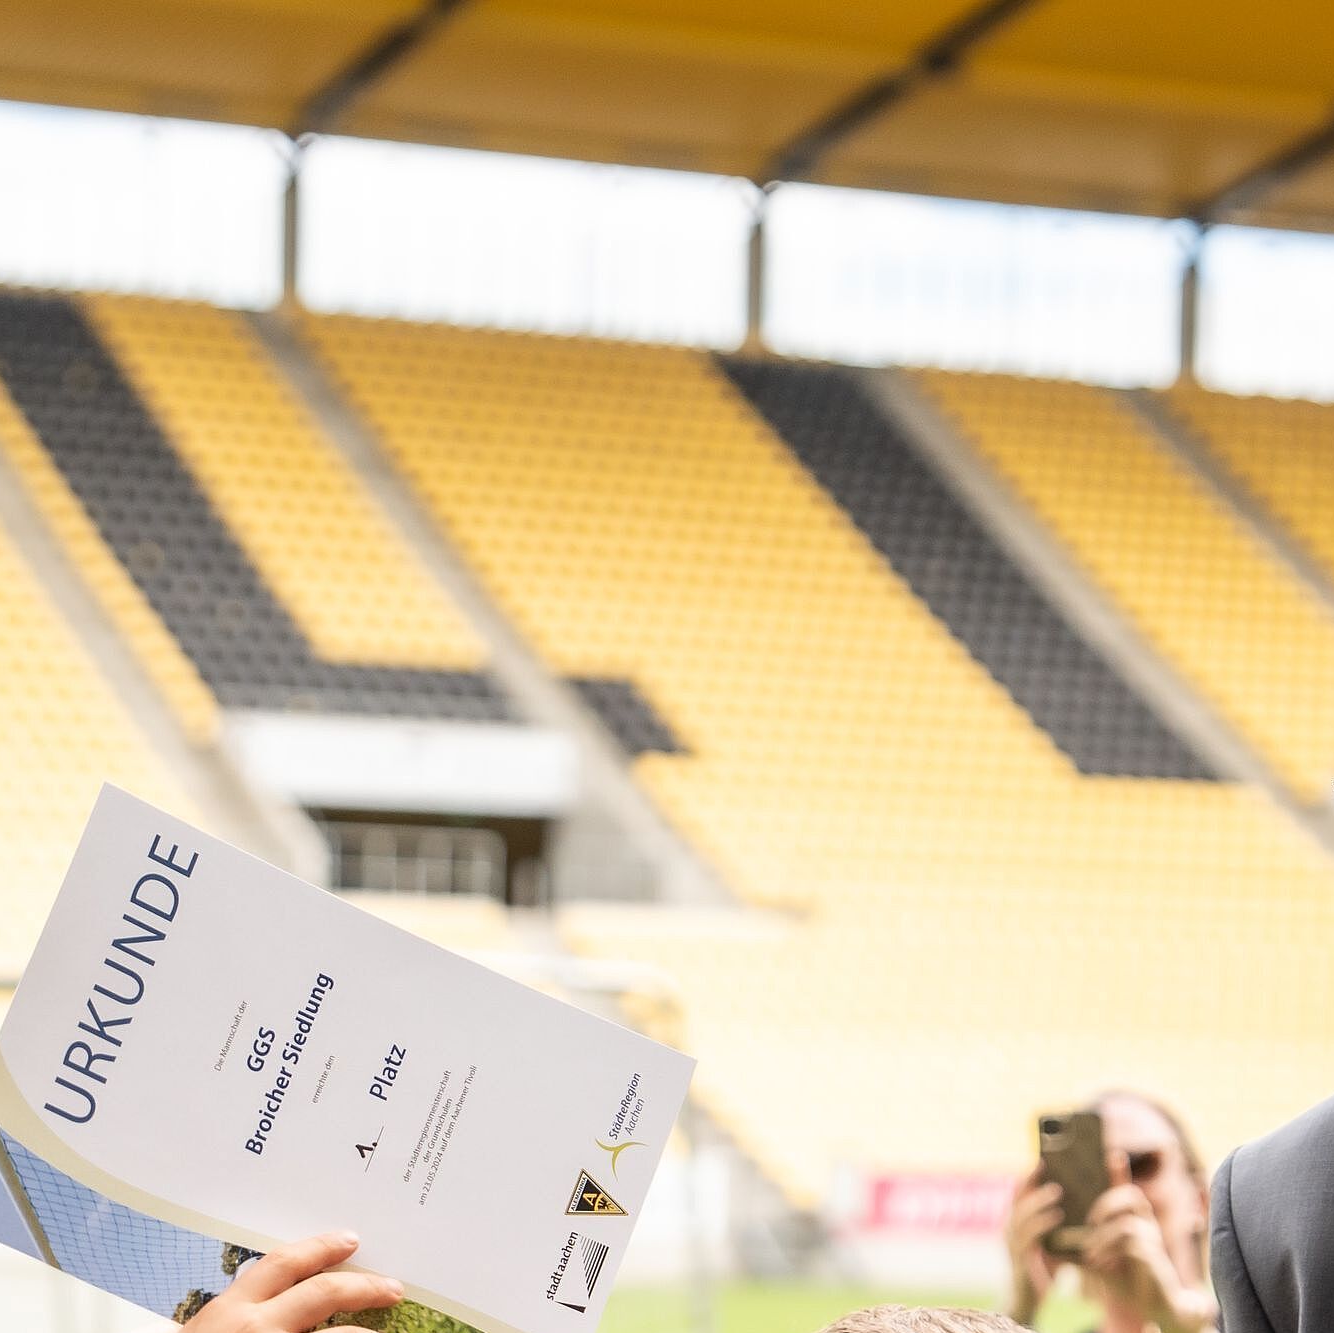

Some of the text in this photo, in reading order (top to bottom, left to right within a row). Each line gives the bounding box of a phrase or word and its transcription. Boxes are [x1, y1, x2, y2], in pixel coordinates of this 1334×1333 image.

[44, 834, 199, 1124] URKUNDE
[214, 1000, 248, 1072] Die Mannschaft der
[245, 973, 334, 1155] Broicher Siedlung
[247, 1026, 276, 1072] GGS
[312, 1055, 335, 1104] erreichte den
[369, 1044, 407, 1101] Platz
[608, 1072, 642, 1140] StädteRegion
[404, 1070, 452, 1183] der Städteregionsmeisterschaft
[419, 1065, 477, 1206] am 23.05.2024 auf dem Aachener Tivoli
[423, 1098, 453, 1164] der Grundschulen
[624, 1098, 645, 1136] Aachen
[546, 1231, 579, 1301] stadt aachen
